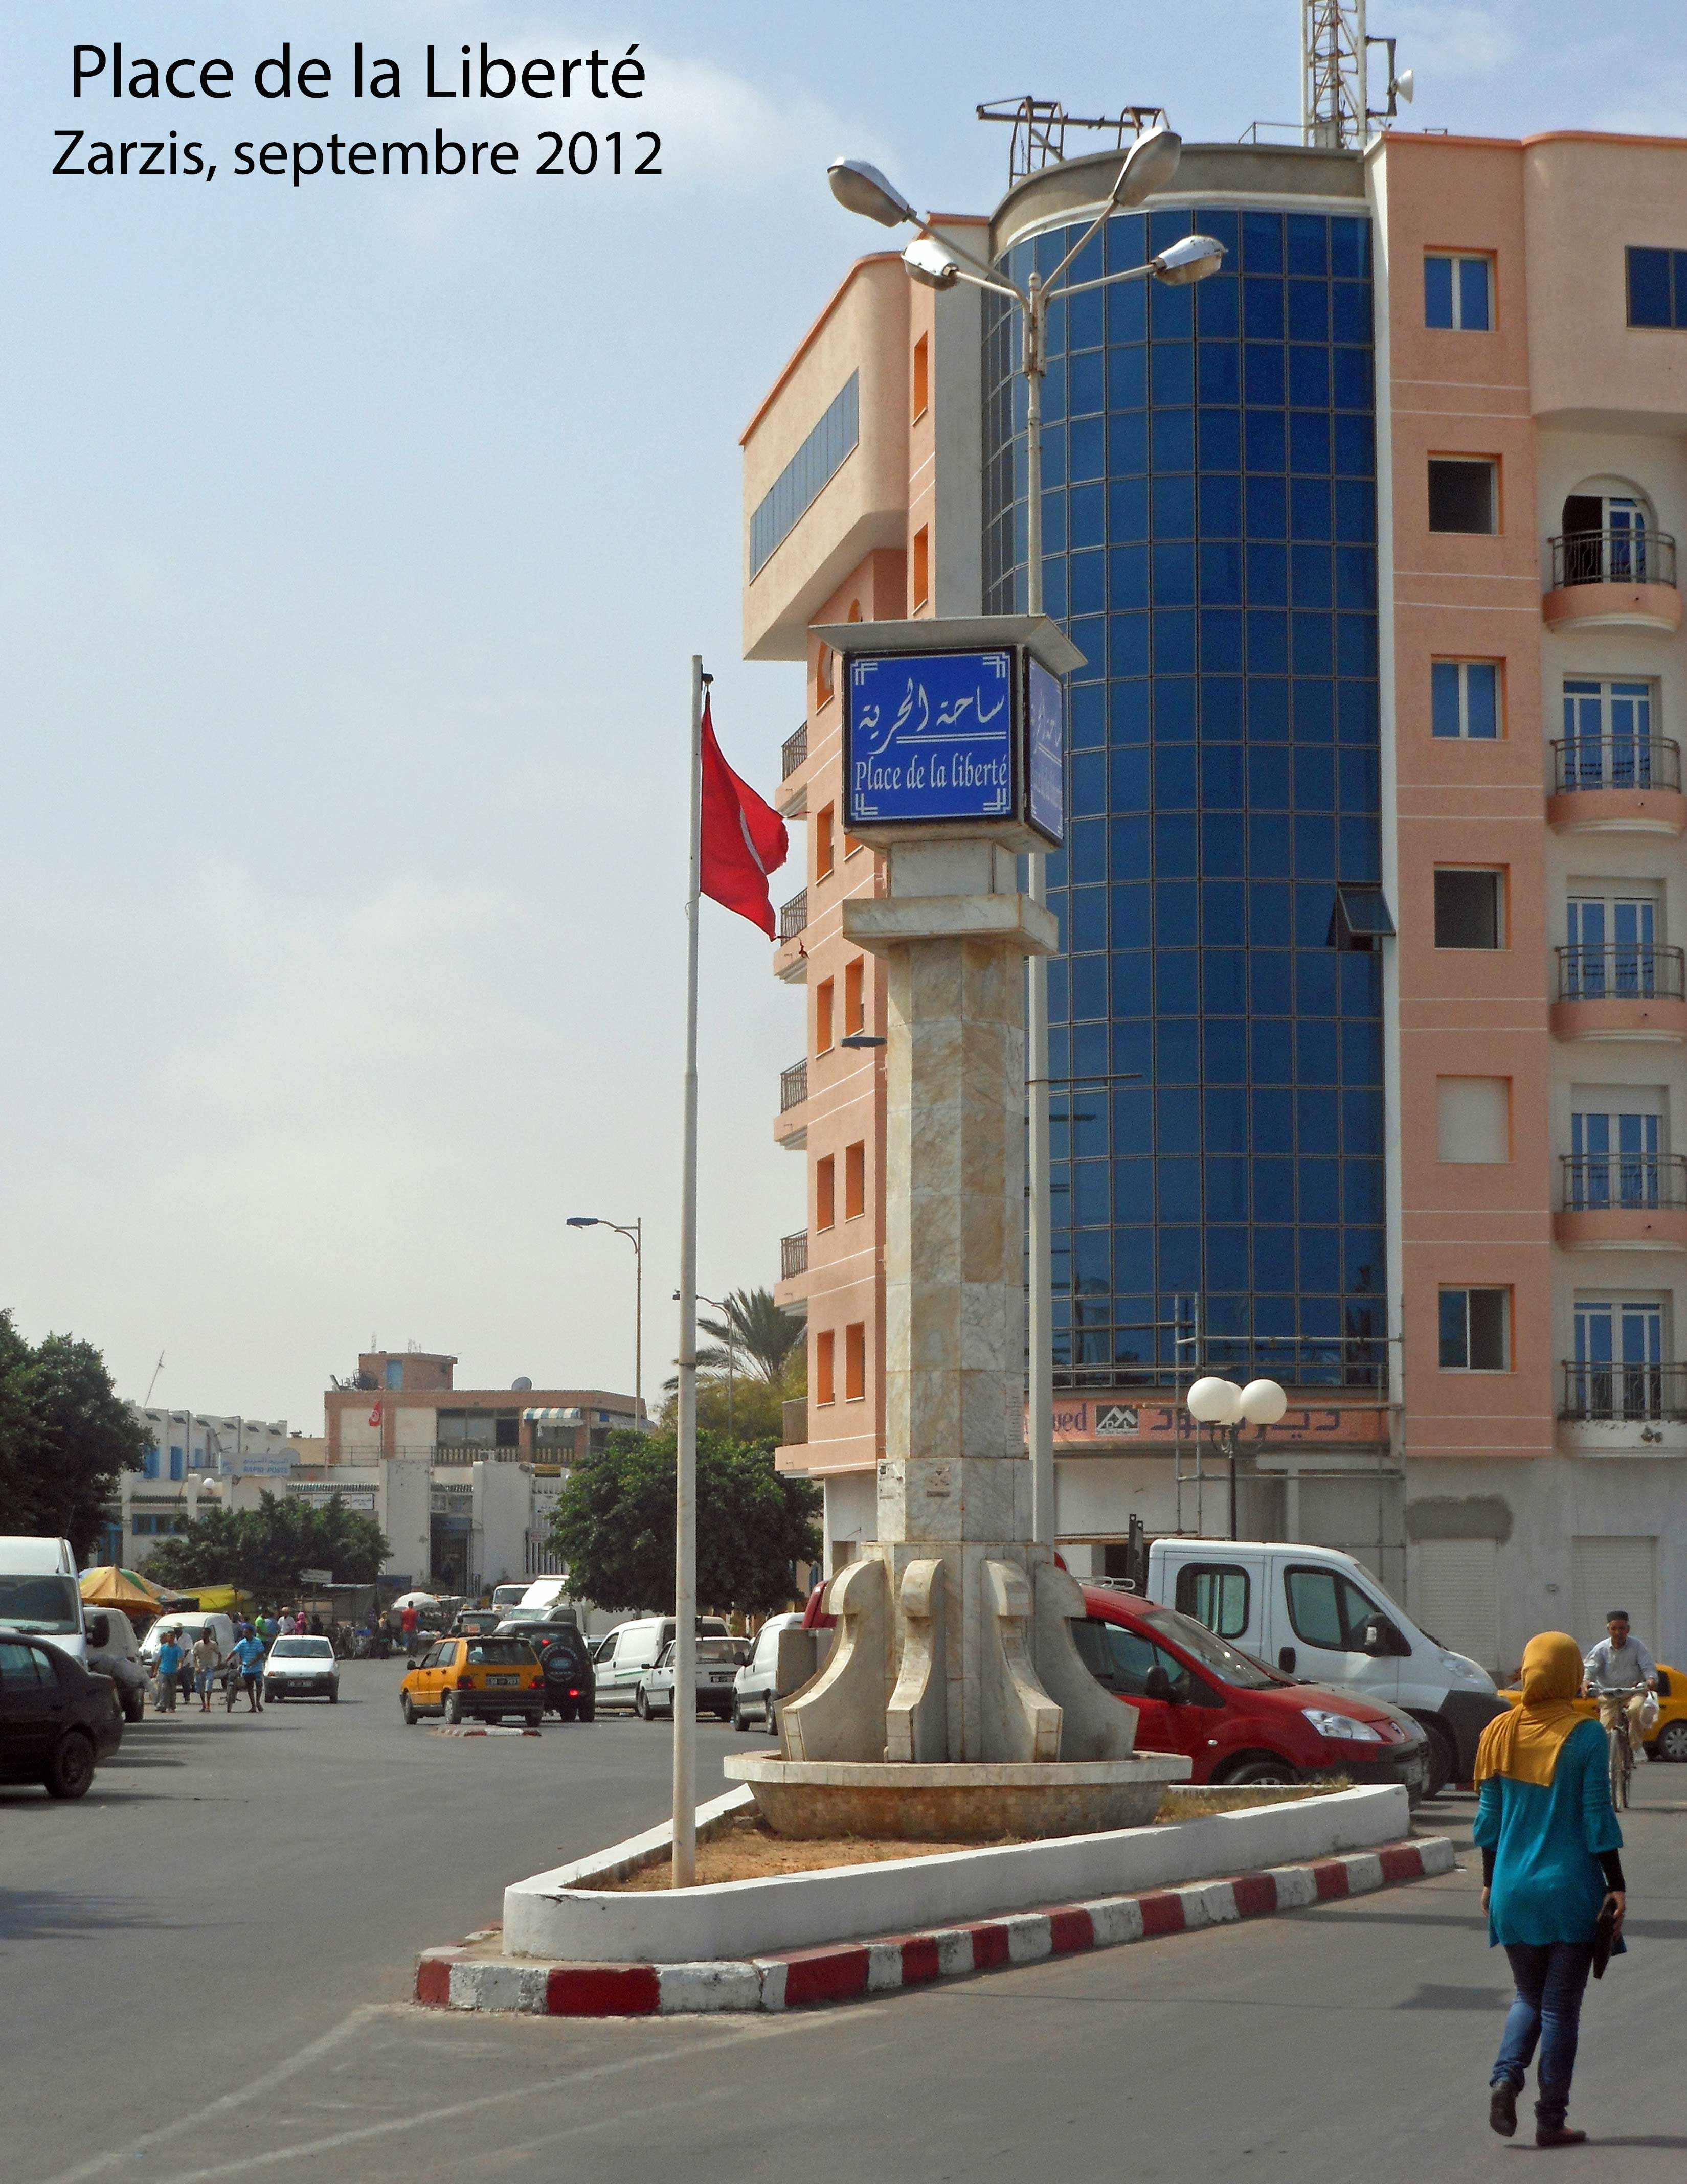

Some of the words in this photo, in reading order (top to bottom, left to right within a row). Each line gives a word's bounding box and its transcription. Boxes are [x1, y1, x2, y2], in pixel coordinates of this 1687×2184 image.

[859, 677, 929, 754] الحرية
[936, 686, 1005, 727] ساحة
[855, 756, 901, 791] Place
[906, 754, 925, 789] de
[930, 753, 947, 788] la
[952, 752, 1007, 788] liberté
